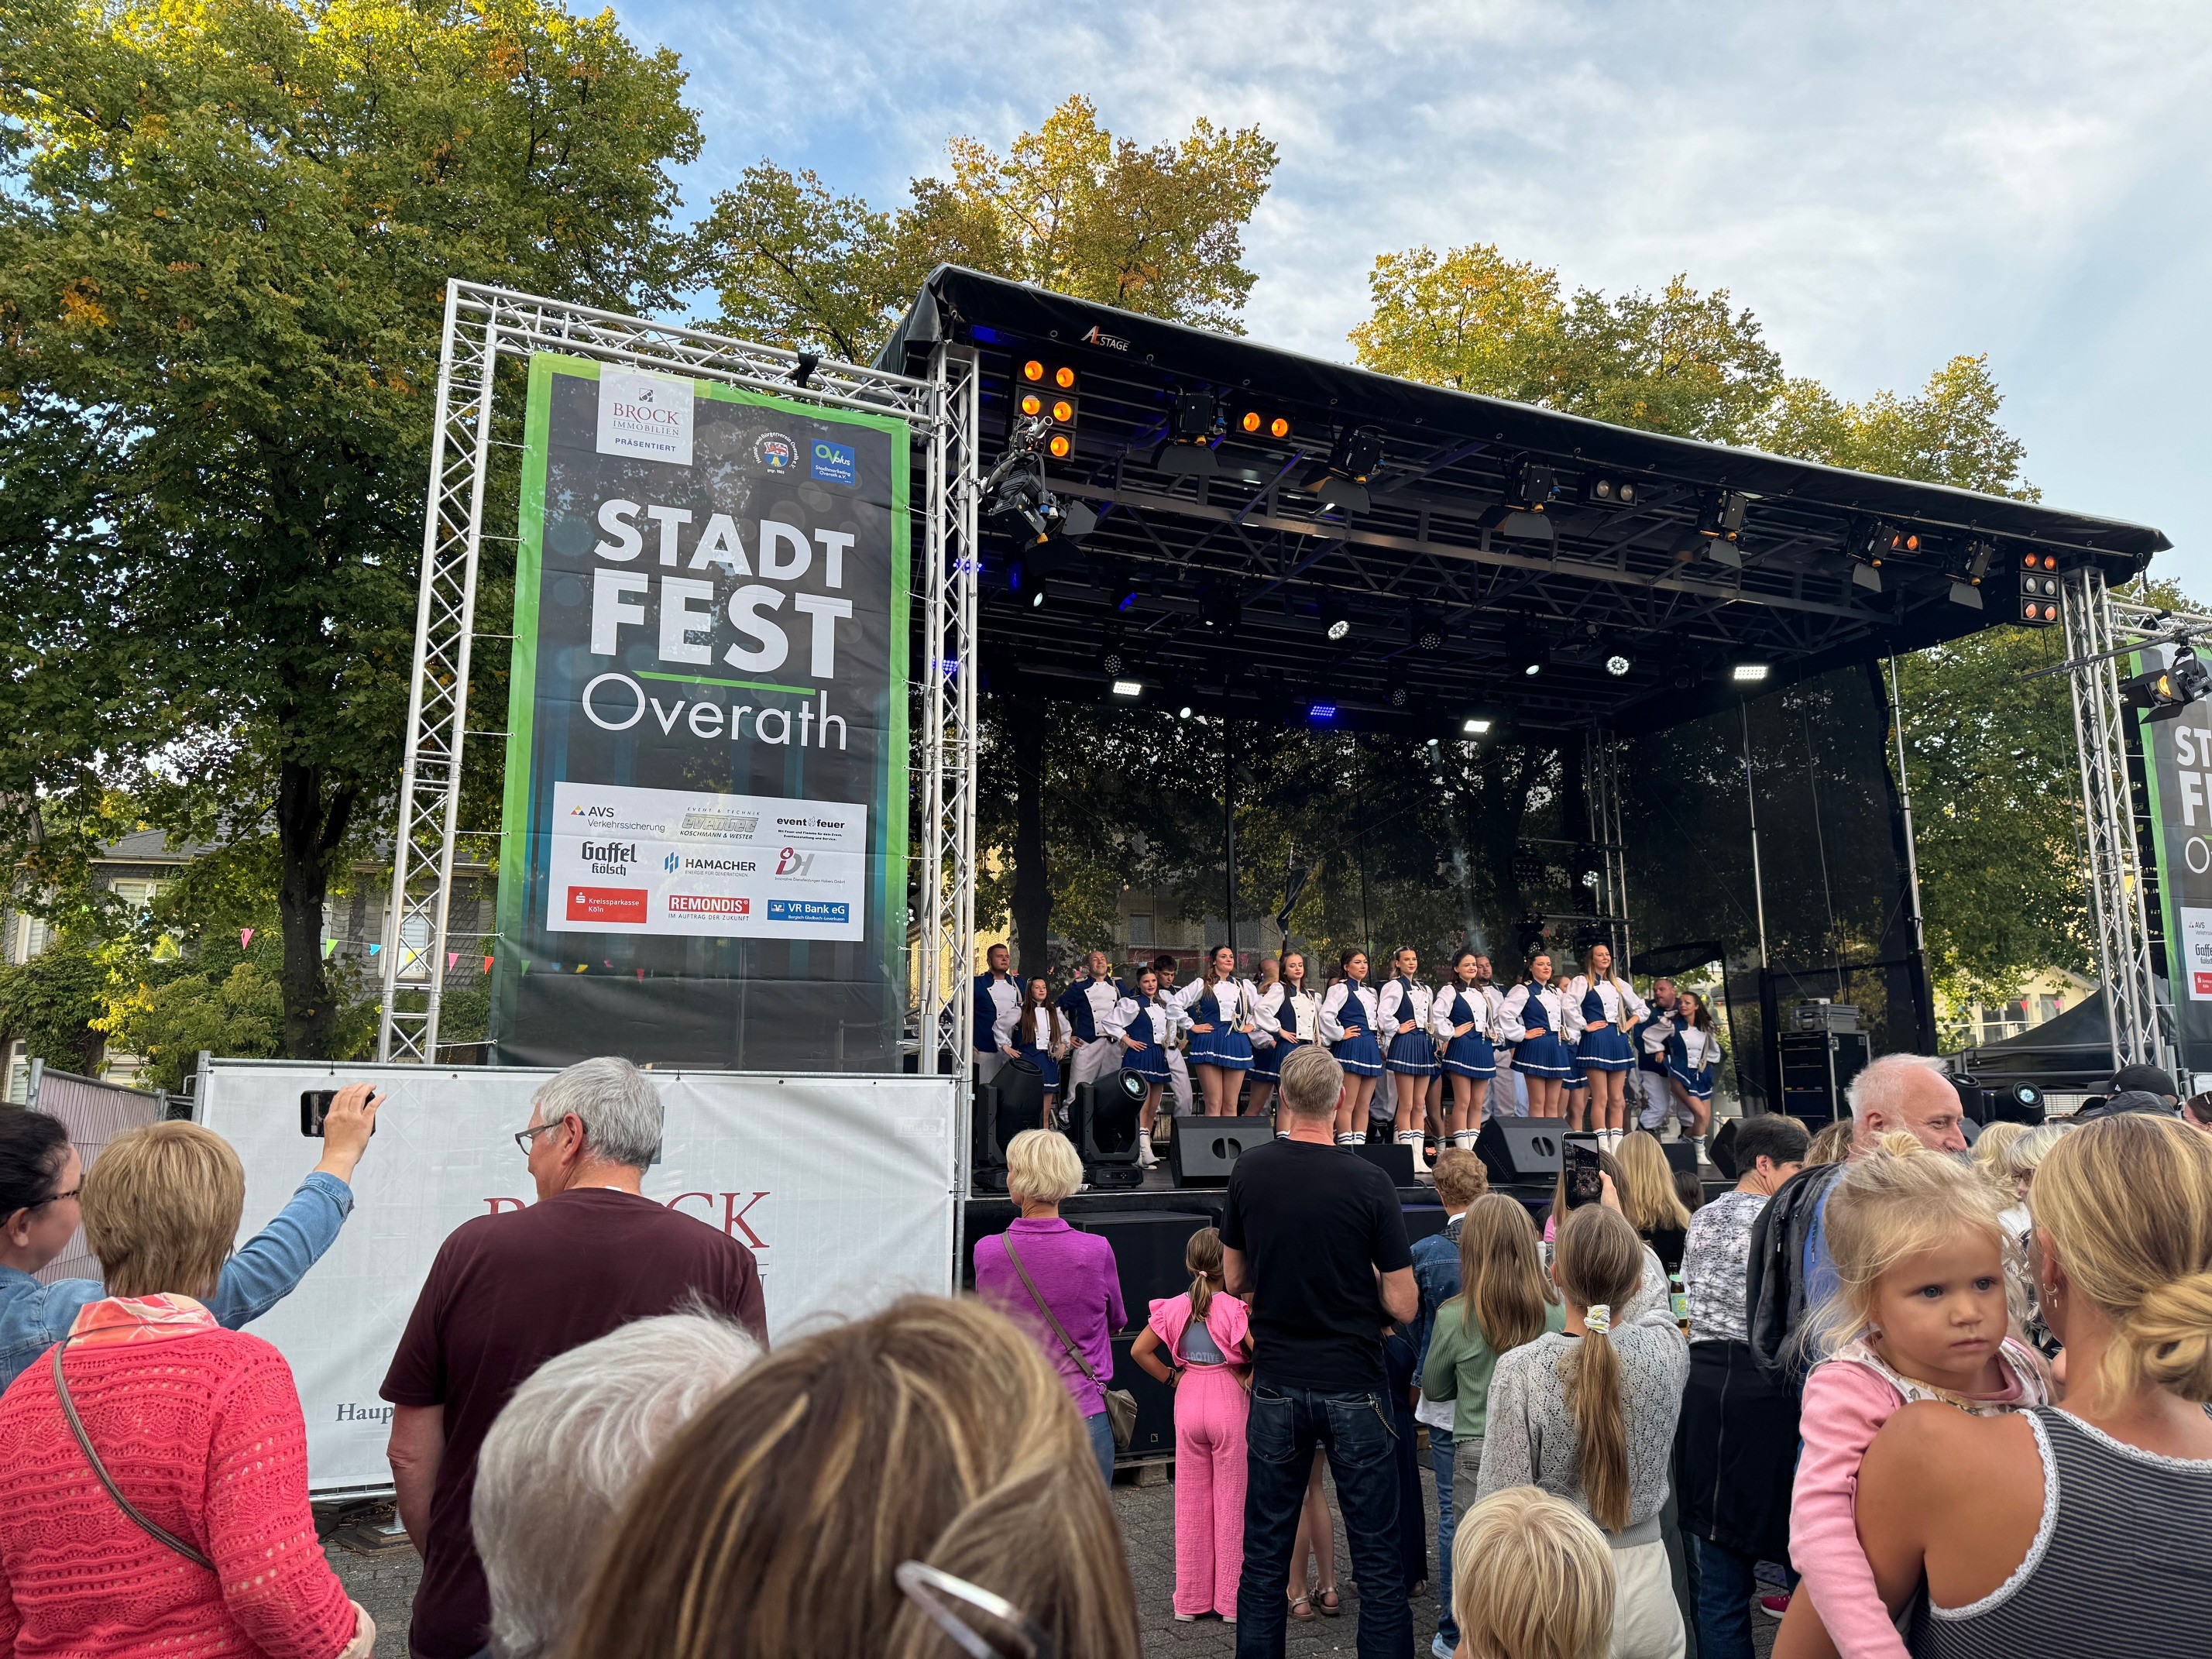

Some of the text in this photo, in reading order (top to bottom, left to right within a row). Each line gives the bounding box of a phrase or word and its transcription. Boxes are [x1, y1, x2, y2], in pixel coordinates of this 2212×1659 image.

[613, 403, 679, 425] BROCK
[613, 421, 679, 436] IMMOBILIEN
[616, 438, 676, 452] PRÄSENTIERT
[816, 465, 851, 477] Stadtmarketing
[594, 499, 855, 589] STADT
[590, 568, 853, 679] FEST
[582, 672, 847, 750] Overath
[2175, 726, 2212, 768] ST
[589, 806, 614, 818] AVS
[588, 819, 665, 833] Verkehrssicherung
[582, 841, 637, 864] Gaffel
[592, 863, 627, 876] Kölsch
[685, 859, 756, 871] HAMACHER
[788, 903, 802, 912] VR
[805, 904, 829, 914] Bank
[335, 1403, 394, 1424] Haup
